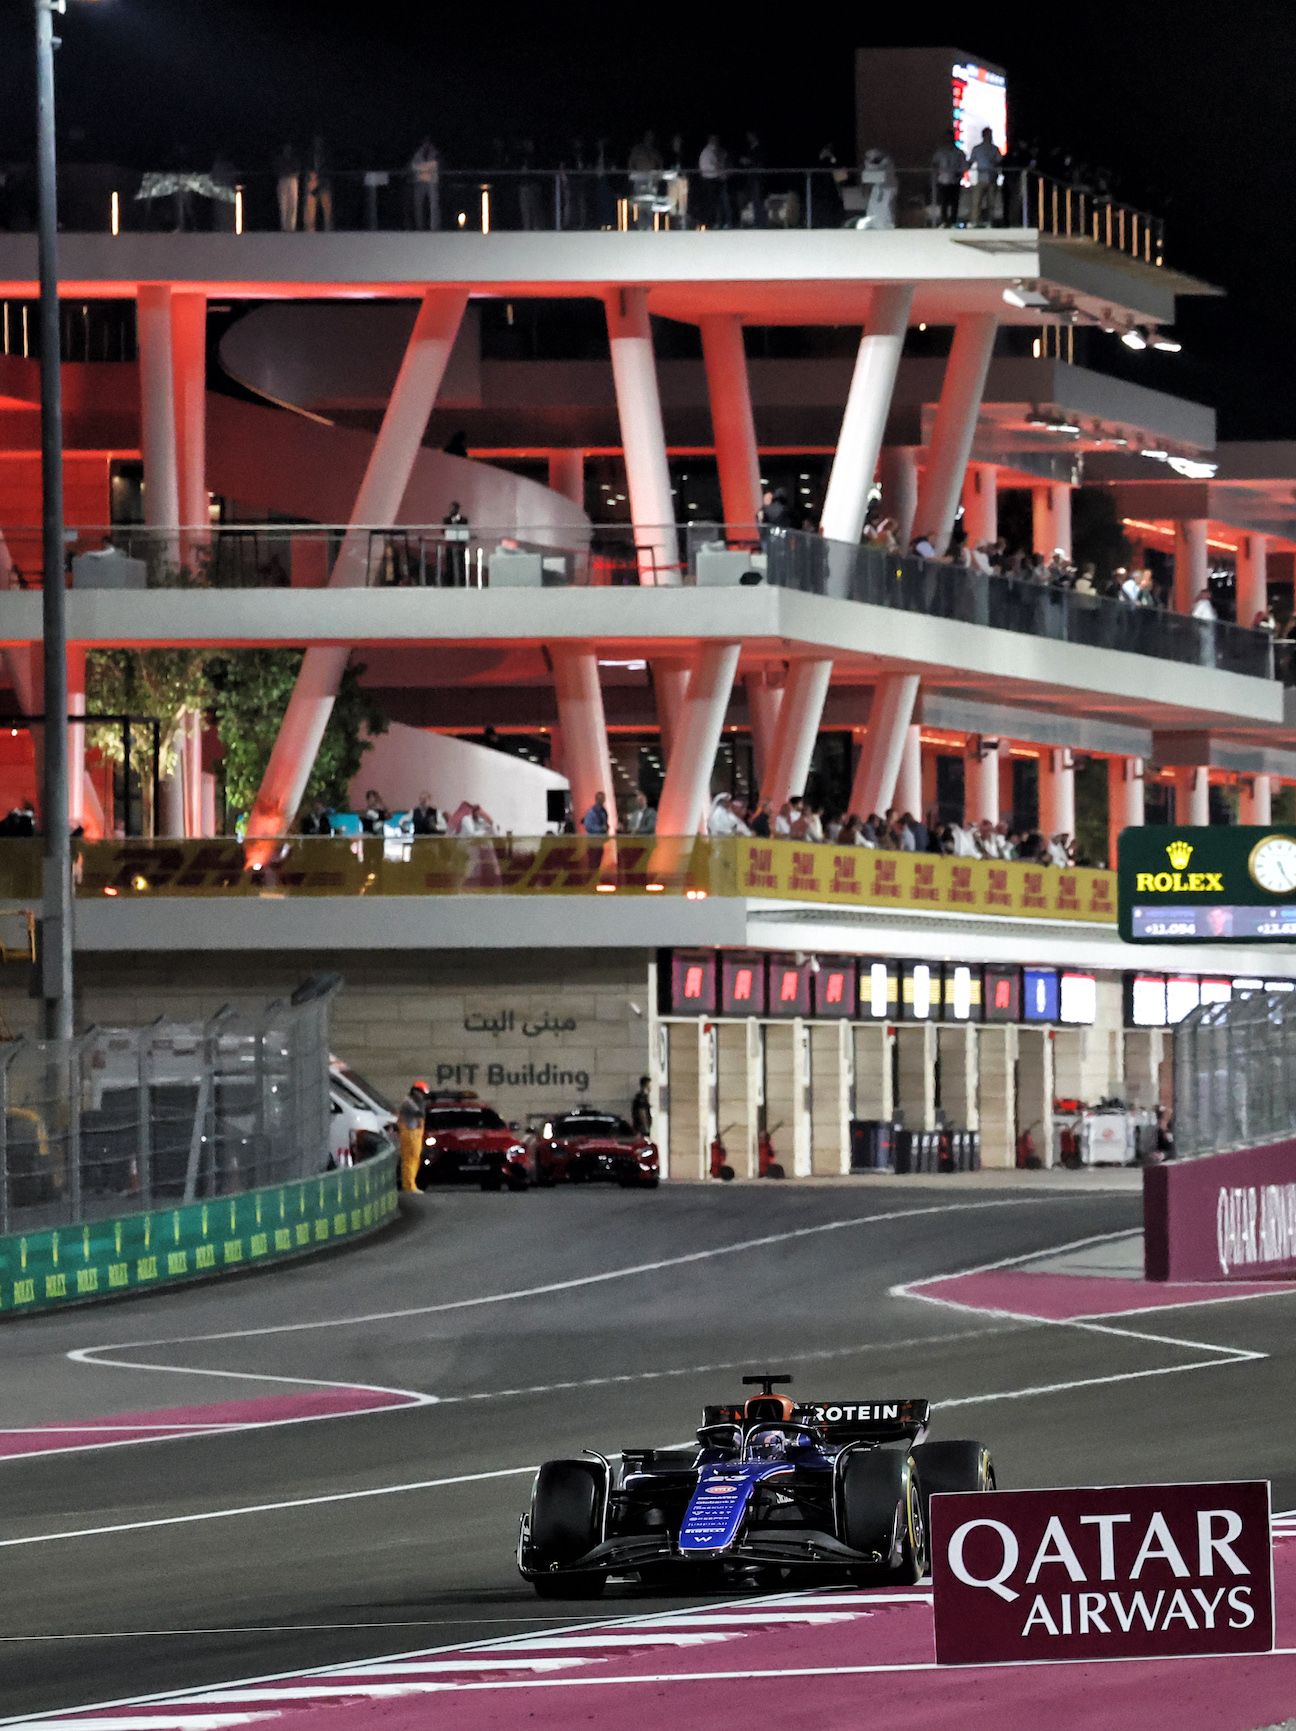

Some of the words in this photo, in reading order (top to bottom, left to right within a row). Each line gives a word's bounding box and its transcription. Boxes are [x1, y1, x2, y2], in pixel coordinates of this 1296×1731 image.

[1136, 872, 1224, 892] ROLEX
[437, 1063, 479, 1086] PIT
[488, 1063, 590, 1092] Building
[812, 1404, 898, 1421] ROTEIN
[948, 1509, 1251, 1603] QATAR
[1022, 1585, 1255, 1636] AIRWAYS
